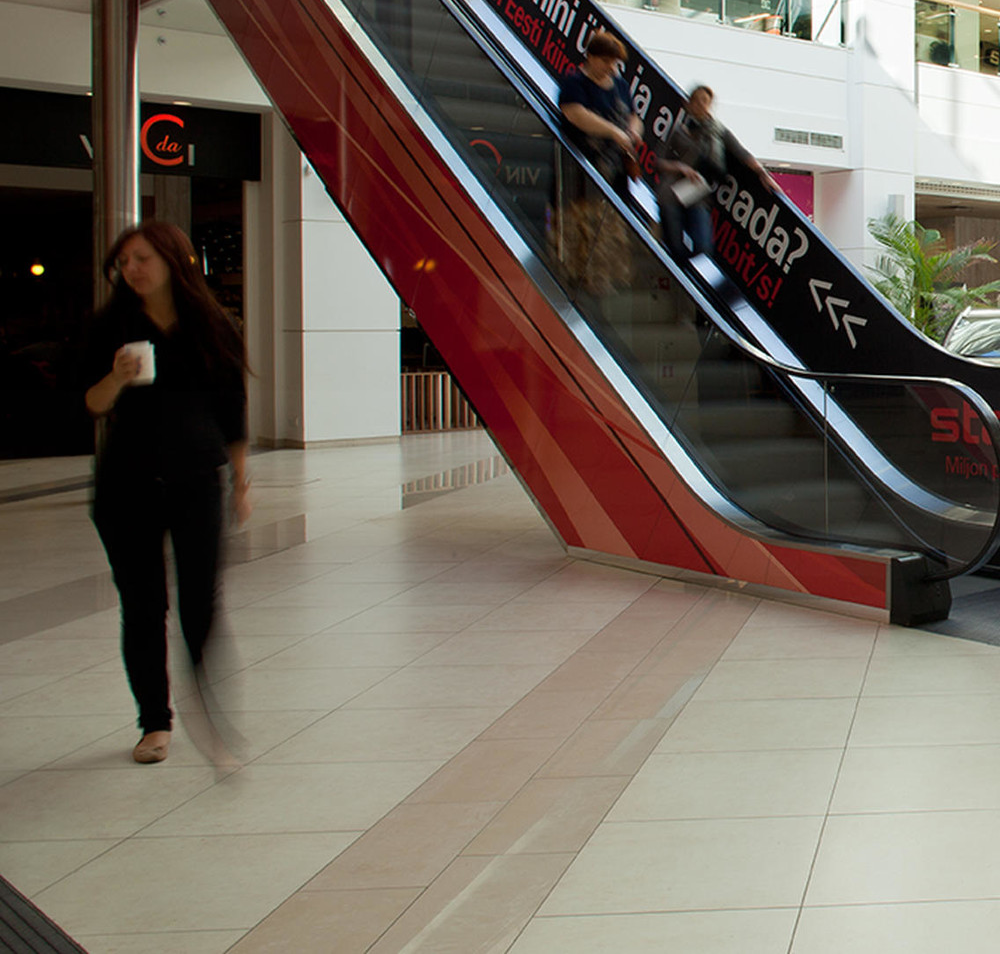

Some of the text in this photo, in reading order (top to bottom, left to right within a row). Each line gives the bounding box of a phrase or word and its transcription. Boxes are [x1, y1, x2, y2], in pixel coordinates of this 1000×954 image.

[630, 64, 652, 120] ja
[711, 174, 809, 274] aada?
[945, 455, 988, 479] Miljon
